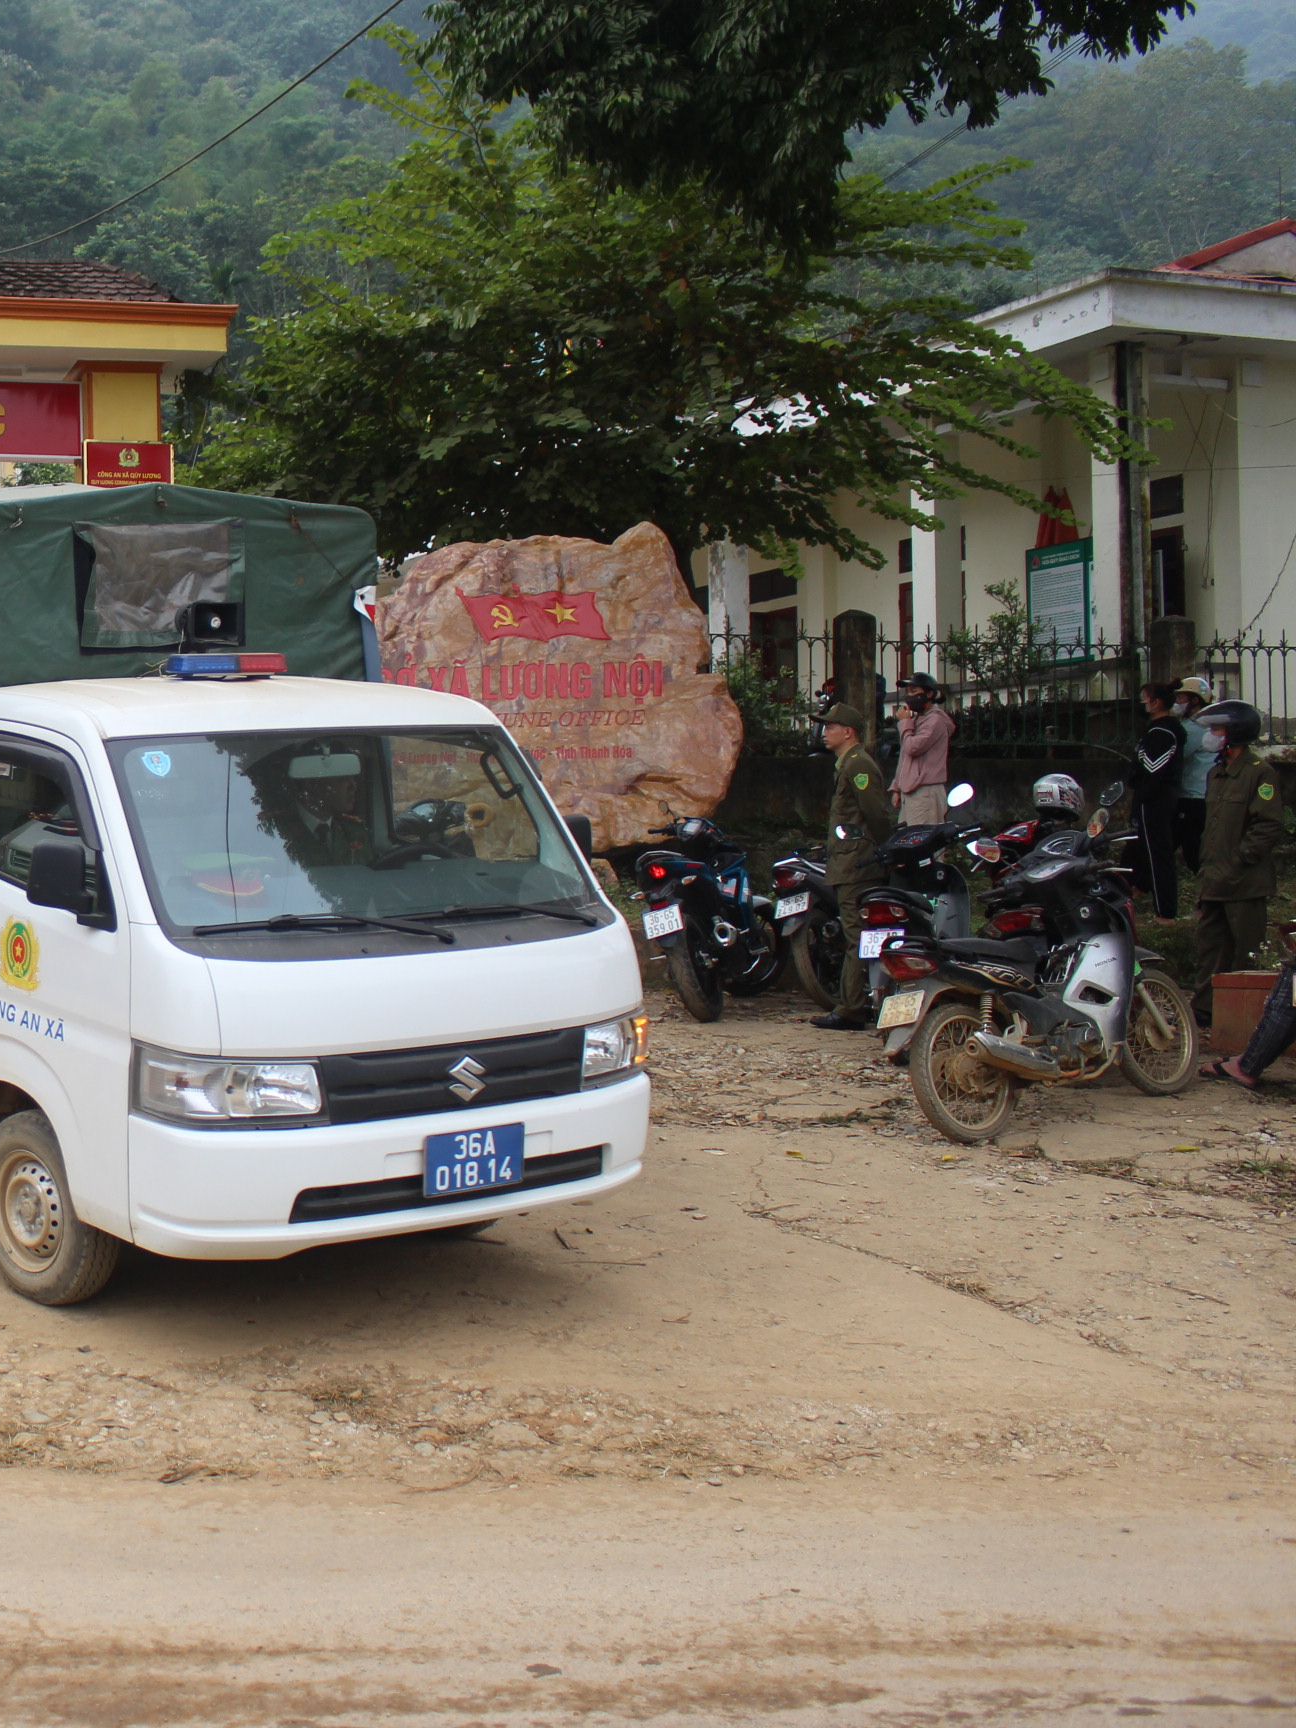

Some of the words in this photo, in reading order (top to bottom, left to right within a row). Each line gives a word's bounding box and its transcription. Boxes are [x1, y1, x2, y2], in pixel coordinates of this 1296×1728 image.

[481, 660, 593, 700] LƯƠNG
[603, 653, 663, 704] NỘI
[559, 709, 646, 728] OFFICE
[579, 746, 611, 759] Thanh
[647, 918, 680, 937] 359.01
[20, 1010, 41, 1033] AN
[44, 1017, 64, 1042] XÃ
[454, 1130, 496, 1160] 36A
[436, 1156, 512, 1191] 018.14
